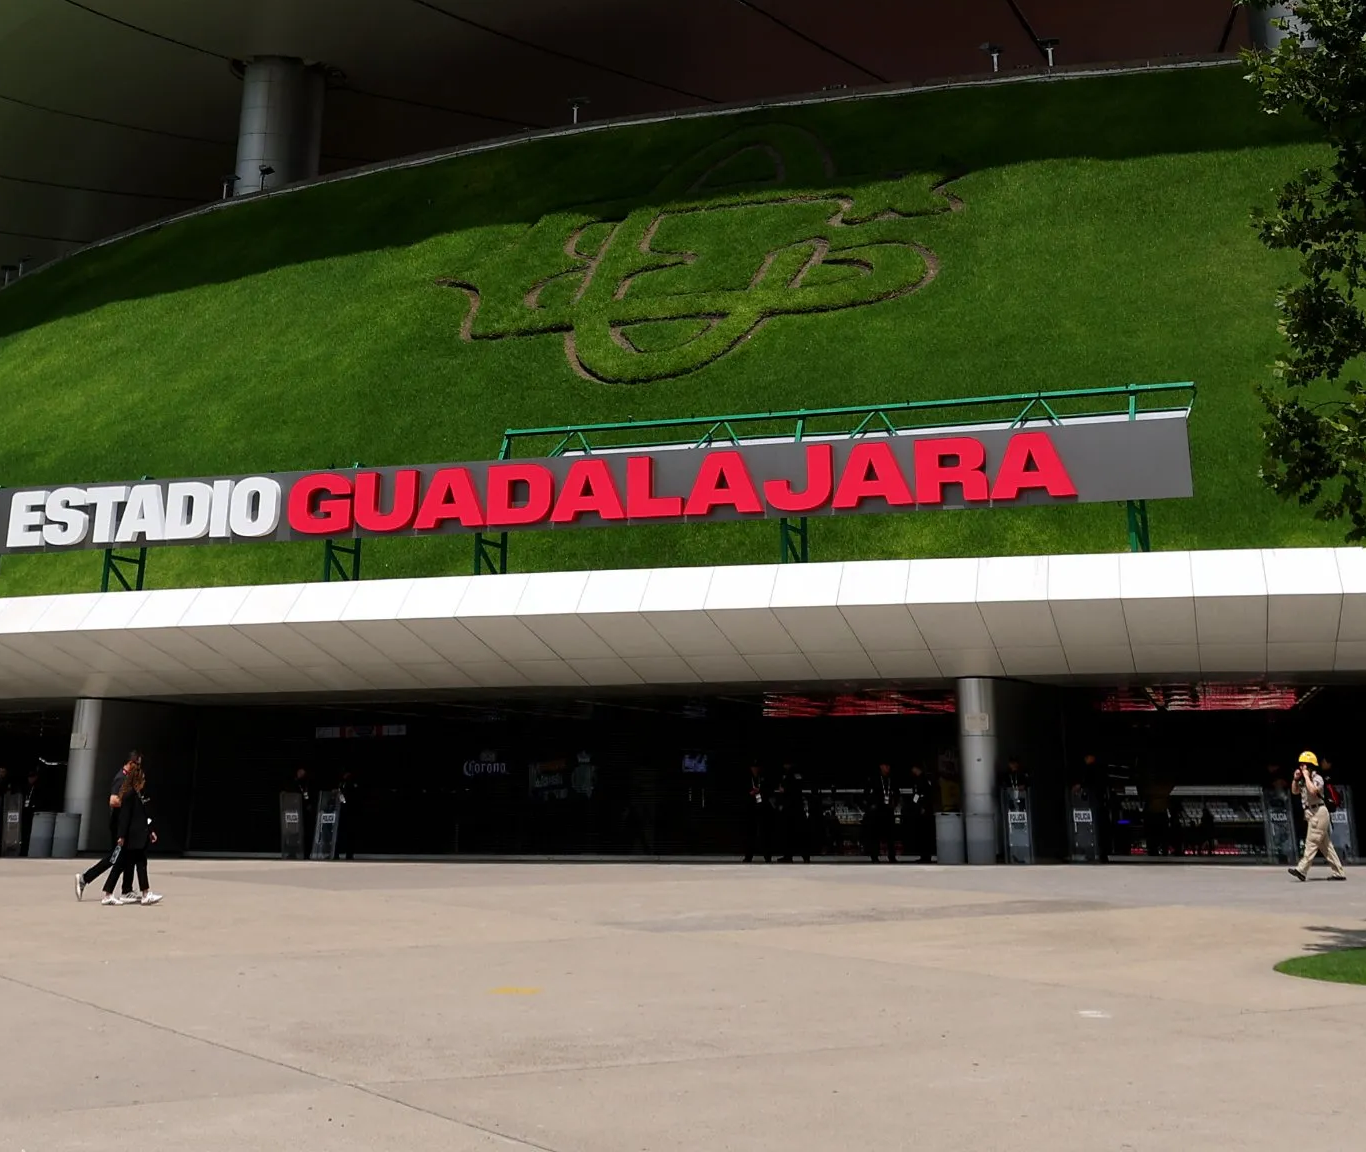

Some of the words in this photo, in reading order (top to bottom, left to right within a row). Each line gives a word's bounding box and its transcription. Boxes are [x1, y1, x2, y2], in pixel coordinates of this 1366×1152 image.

[6, 476, 281, 547] ESTADIO
[287, 432, 1078, 534] GUADALAJARA
[463, 759, 506, 777] Corona
